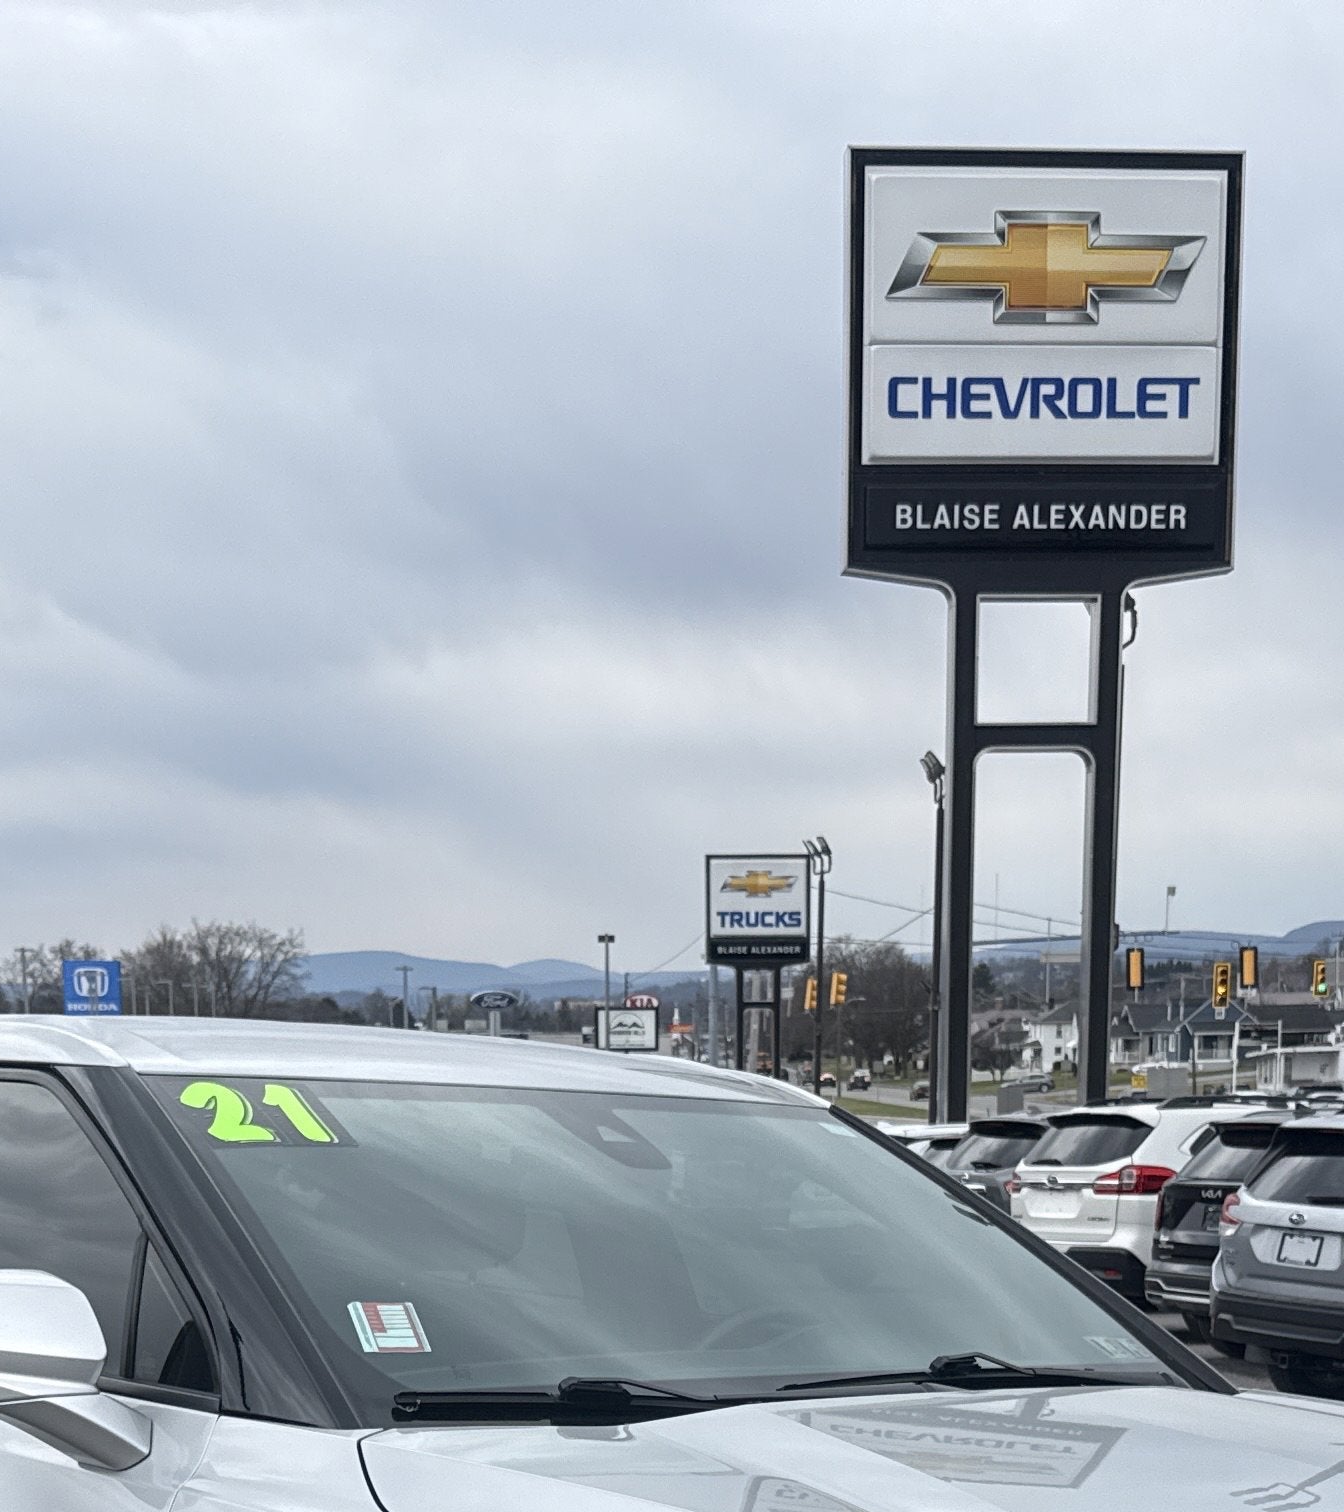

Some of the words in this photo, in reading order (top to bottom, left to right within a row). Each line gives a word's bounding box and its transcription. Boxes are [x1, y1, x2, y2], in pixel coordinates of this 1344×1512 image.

[887, 376, 1201, 420] CHEVROLET
[895, 503, 1001, 531] BLAISE
[1012, 503, 1187, 531] ALEXANDER
[716, 911, 802, 928] TRUCKS
[750, 946, 801, 955] ALEXANDER
[179, 1081, 339, 1144] 21
